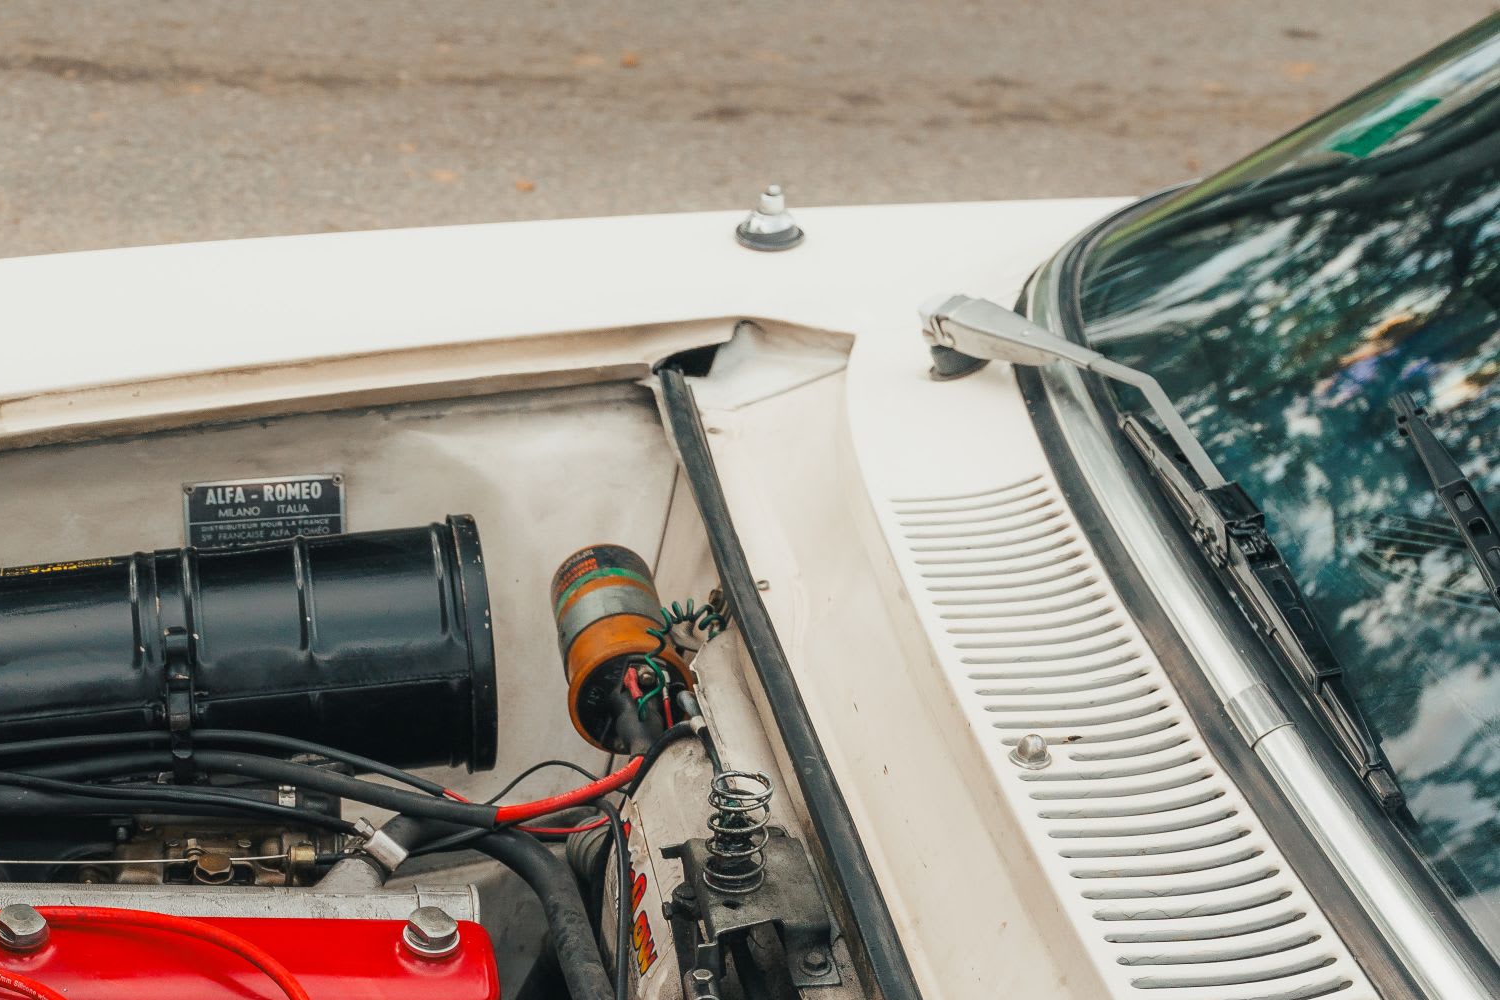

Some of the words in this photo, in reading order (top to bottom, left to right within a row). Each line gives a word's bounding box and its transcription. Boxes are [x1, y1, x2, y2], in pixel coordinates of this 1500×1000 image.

[206, 486, 246, 505] ALFA
[263, 482, 322, 502] ROMEO
[218, 506, 260, 518] MILANO
[277, 504, 310, 514] ITALIA
[201, 522, 258, 532] DISTRIBUTEUR
[270, 528, 290, 537] ALFA
[14, 980, 37, 995] Silicone
